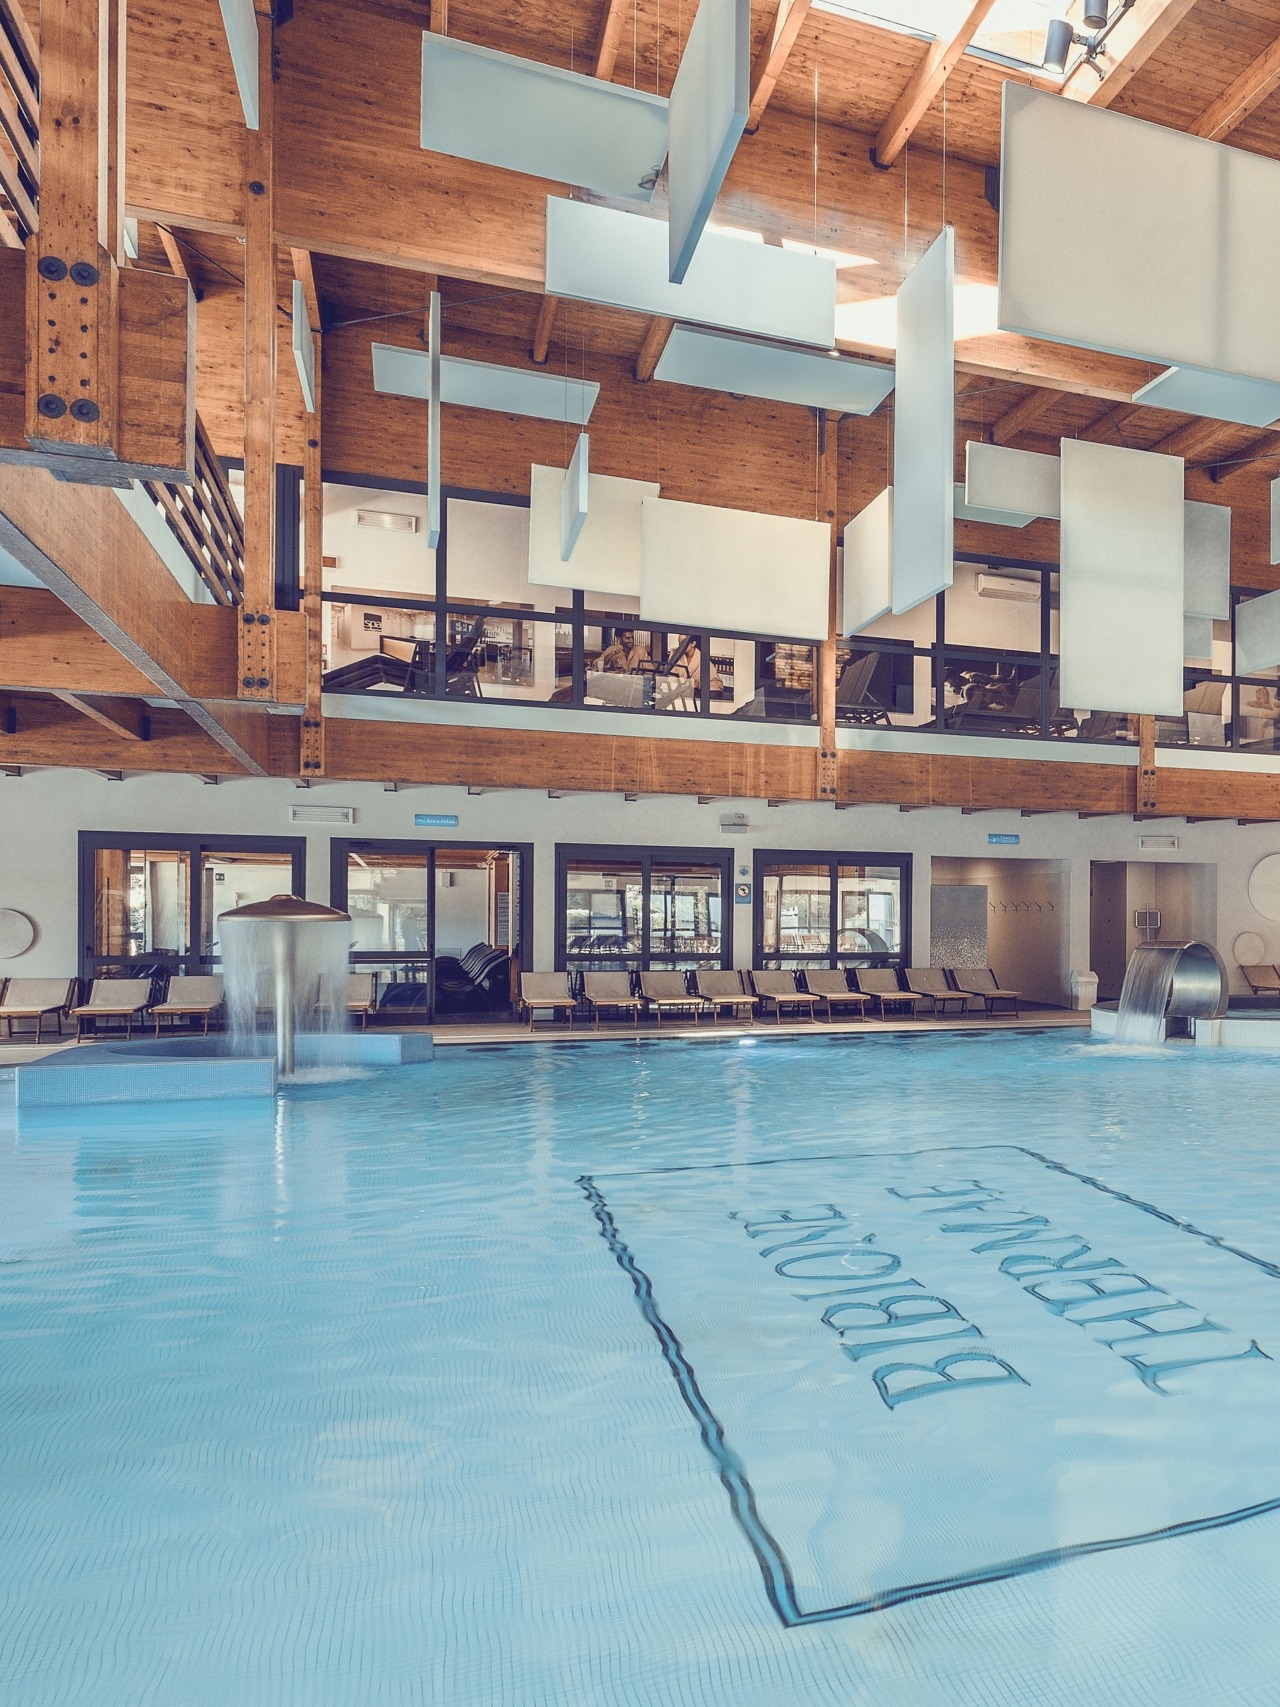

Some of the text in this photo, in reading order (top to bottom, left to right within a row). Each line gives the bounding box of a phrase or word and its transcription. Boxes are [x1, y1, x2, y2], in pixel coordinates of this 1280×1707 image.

[365, 619, 382, 630] spa
[727, 1203, 1031, 1411] BIBIONE
[885, 1179, 1274, 1397] THERMAE
